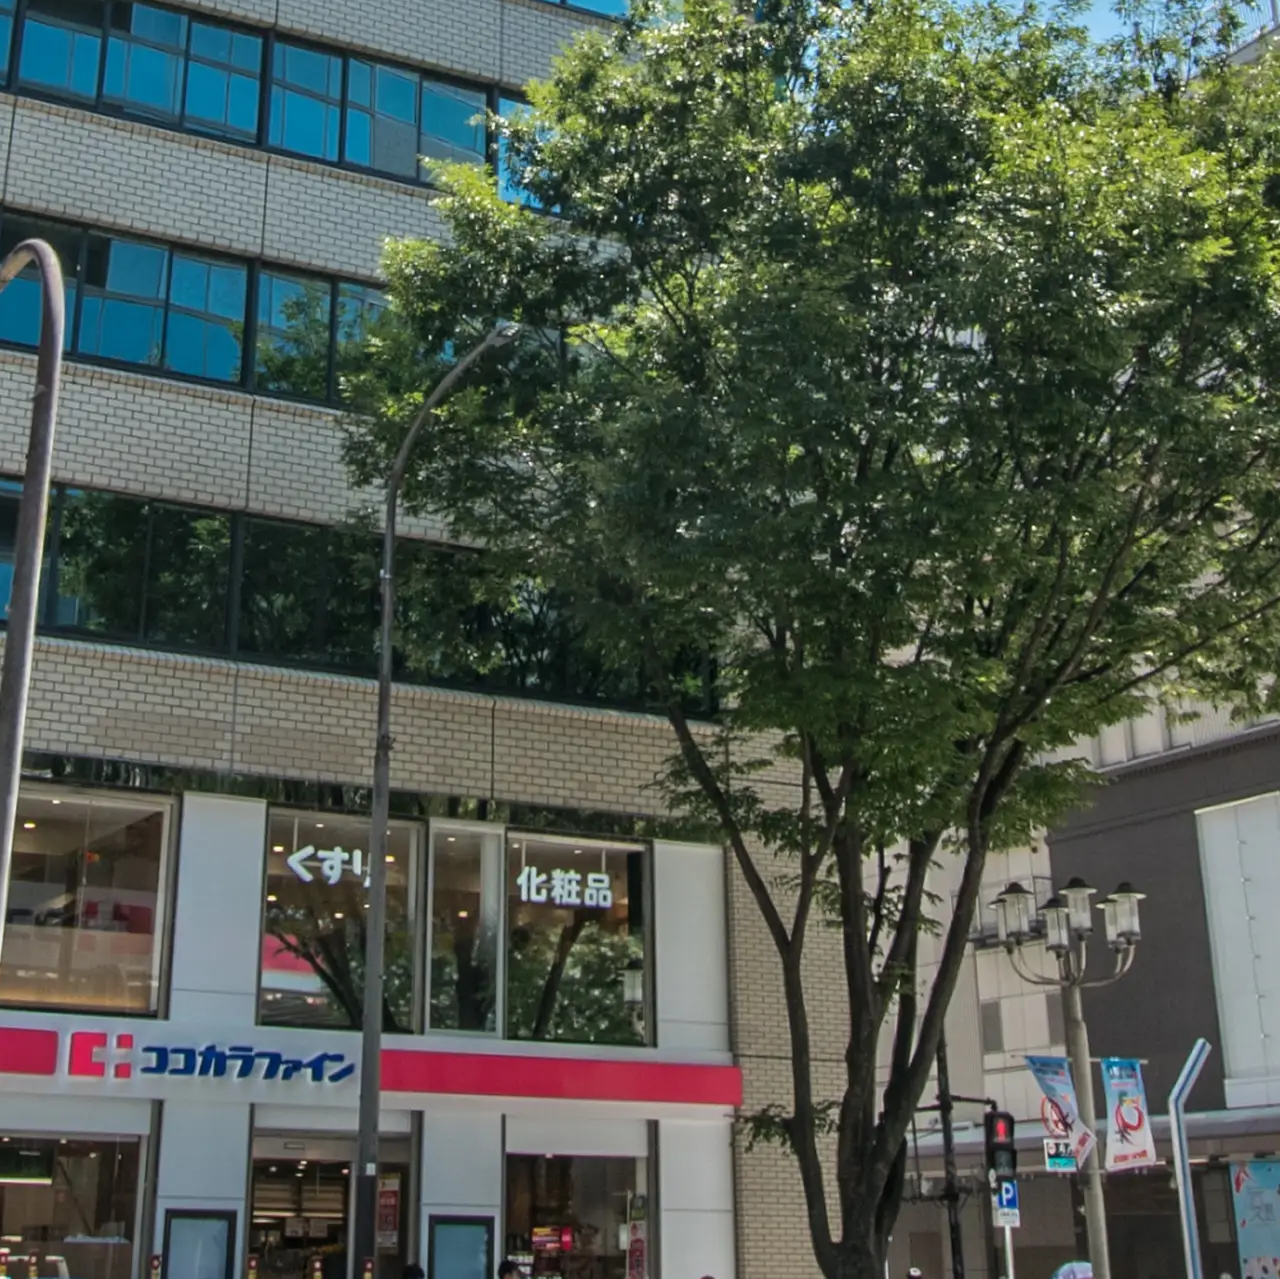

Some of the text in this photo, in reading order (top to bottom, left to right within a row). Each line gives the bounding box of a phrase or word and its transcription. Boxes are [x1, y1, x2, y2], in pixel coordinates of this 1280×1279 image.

[516, 865, 613, 908] 化粧品
[140, 1043, 356, 1083] ココカラファイン
[1001, 1181, 1014, 1206] P
